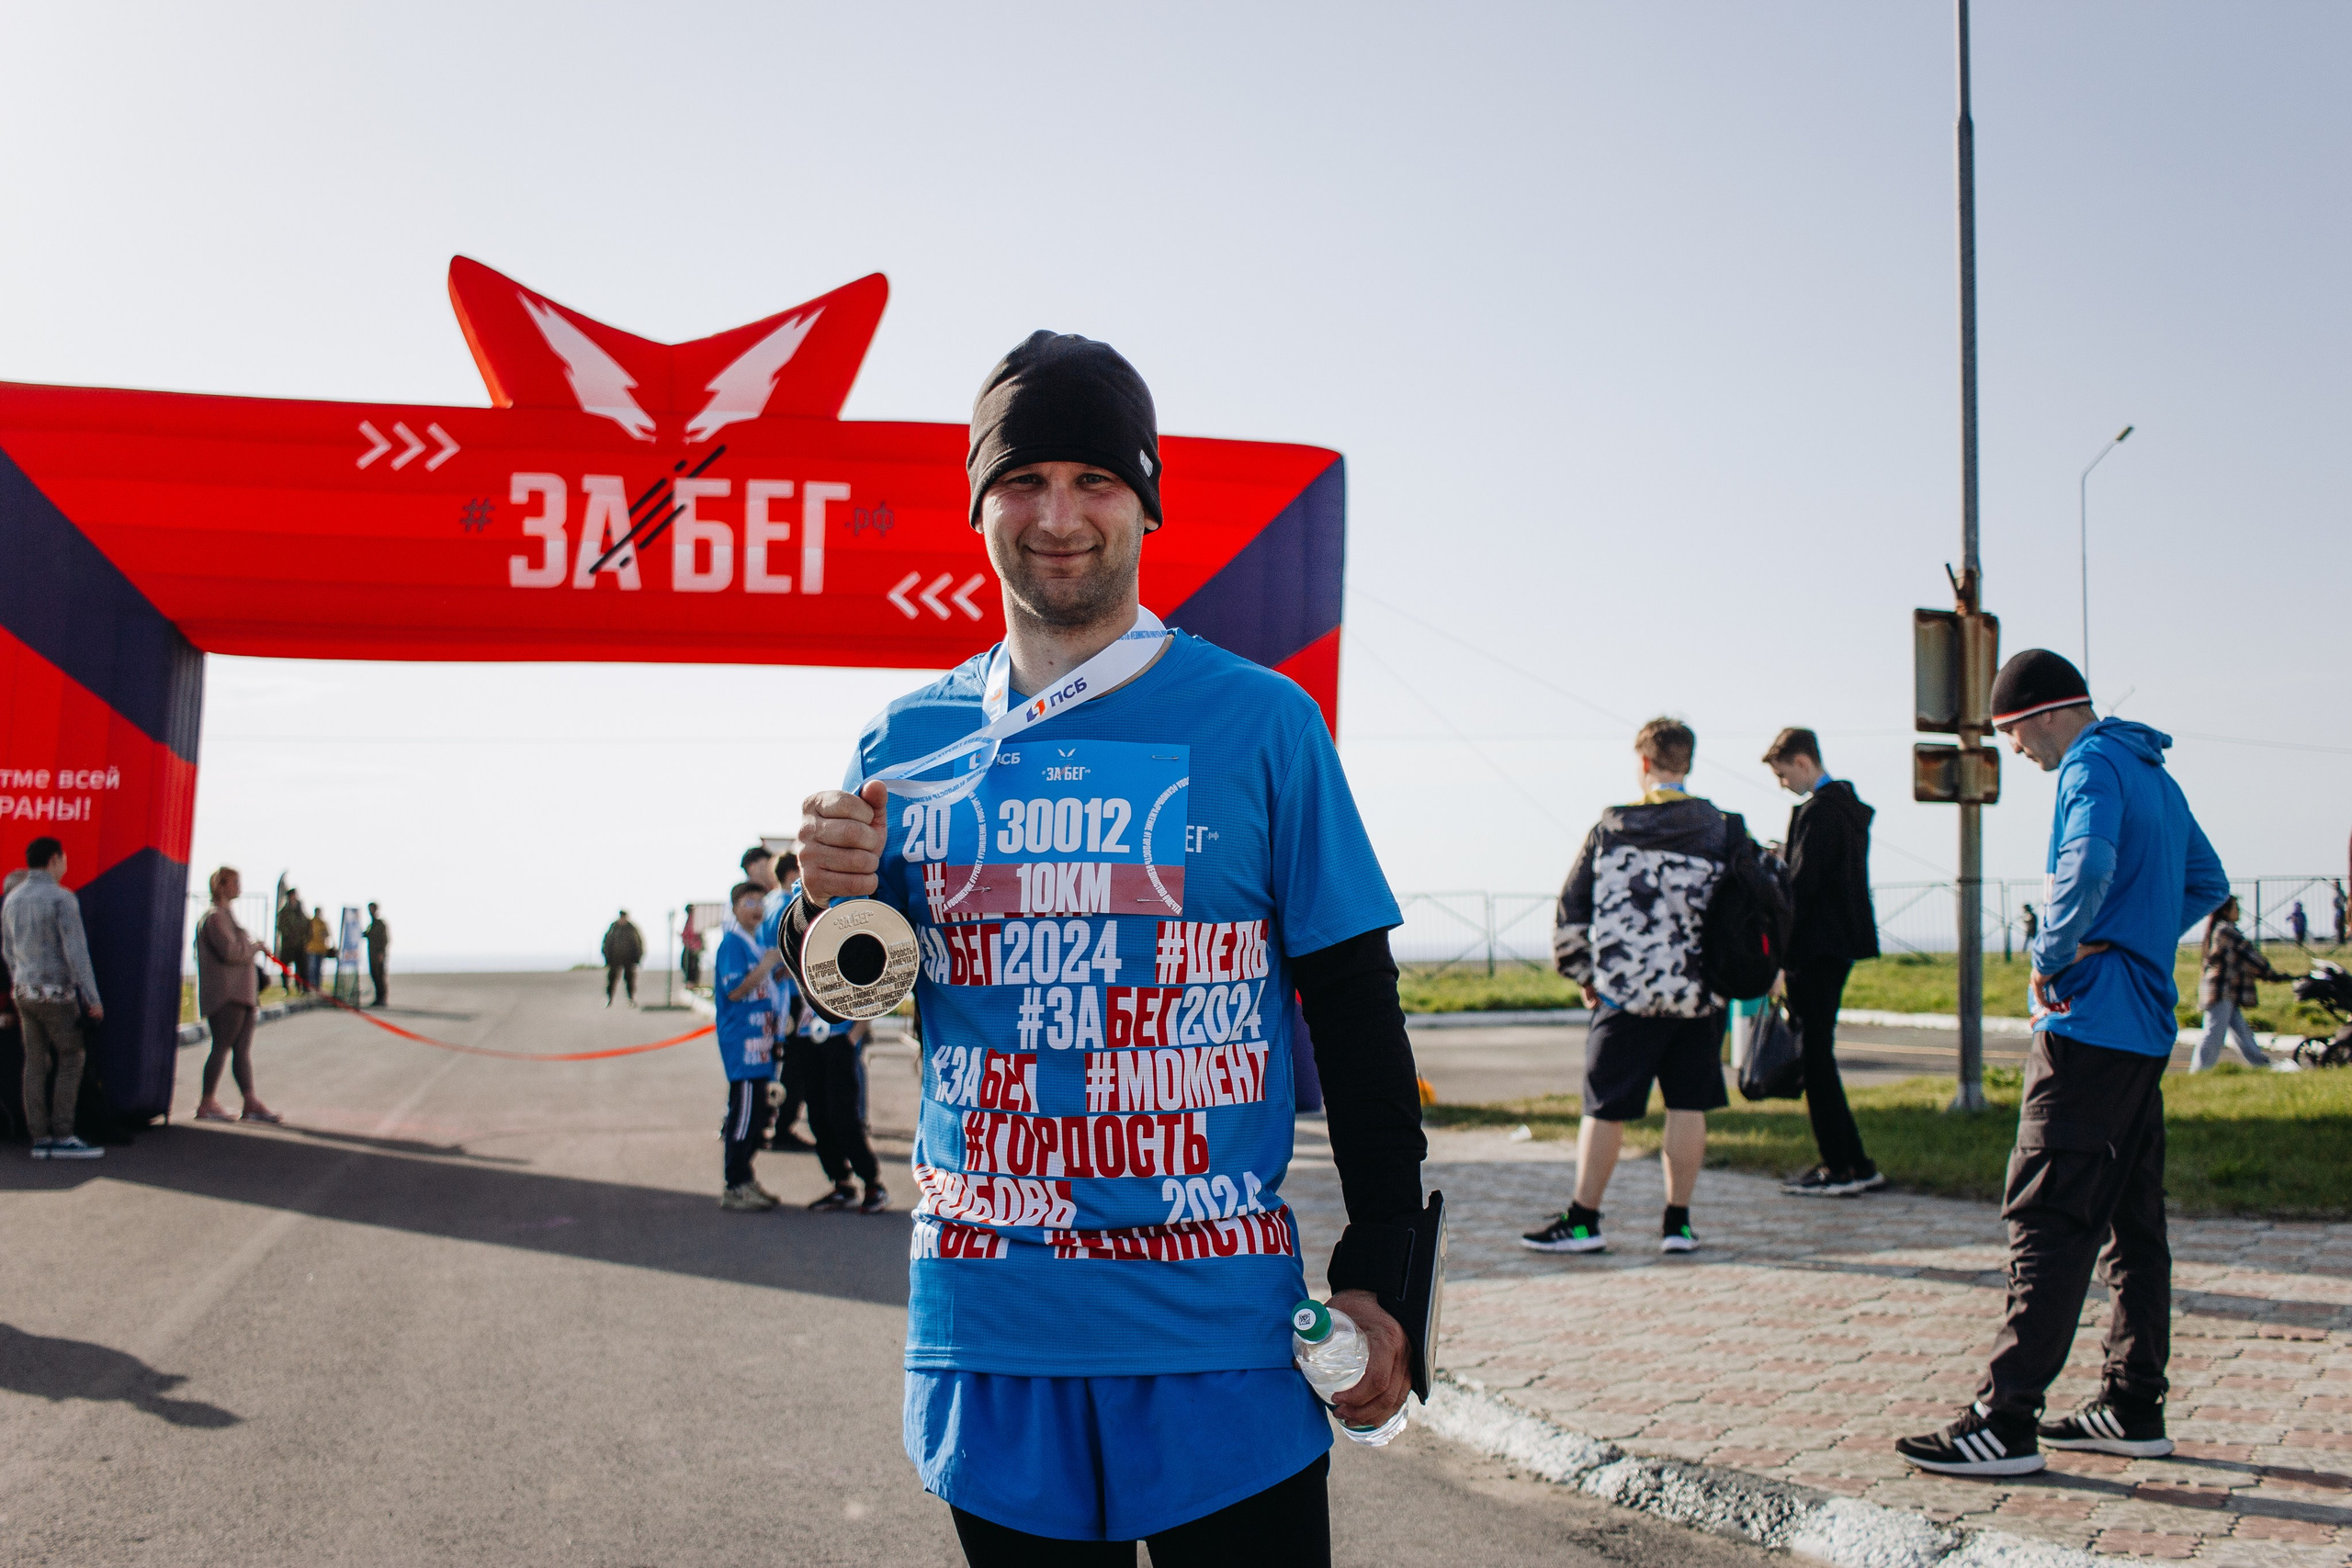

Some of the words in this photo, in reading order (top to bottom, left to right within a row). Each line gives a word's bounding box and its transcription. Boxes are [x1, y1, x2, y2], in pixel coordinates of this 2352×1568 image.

[1049, 676, 1088, 707] ПСБ
[58, 764, 120, 790] всей
[997, 797, 1132, 853] 30012
[1142, 831, 1153, 865] #ГОРДОСТЬ
[969, 859, 983, 884] #ТРЕПЕТ
[1016, 862, 1112, 913] 10КМ
[1146, 864, 1167, 897] #ЕДИНСТВО
[1162, 894, 1182, 916] #МЕЧТА
[1156, 919, 1269, 984] #ЦЕЛЬ
[853, 987, 878, 1000] #МОМЕНТ
[874, 989, 904, 1002] #ЕДИНСТВО
[1017, 980, 1265, 1050] #ЗАБЕГ2024
[932, 1045, 1039, 1113] #ЗАБЕГ
[1084, 1041, 1269, 1112] #МОМЕНТ
[963, 1111, 1210, 1179] #ГОРДОСТЬ
